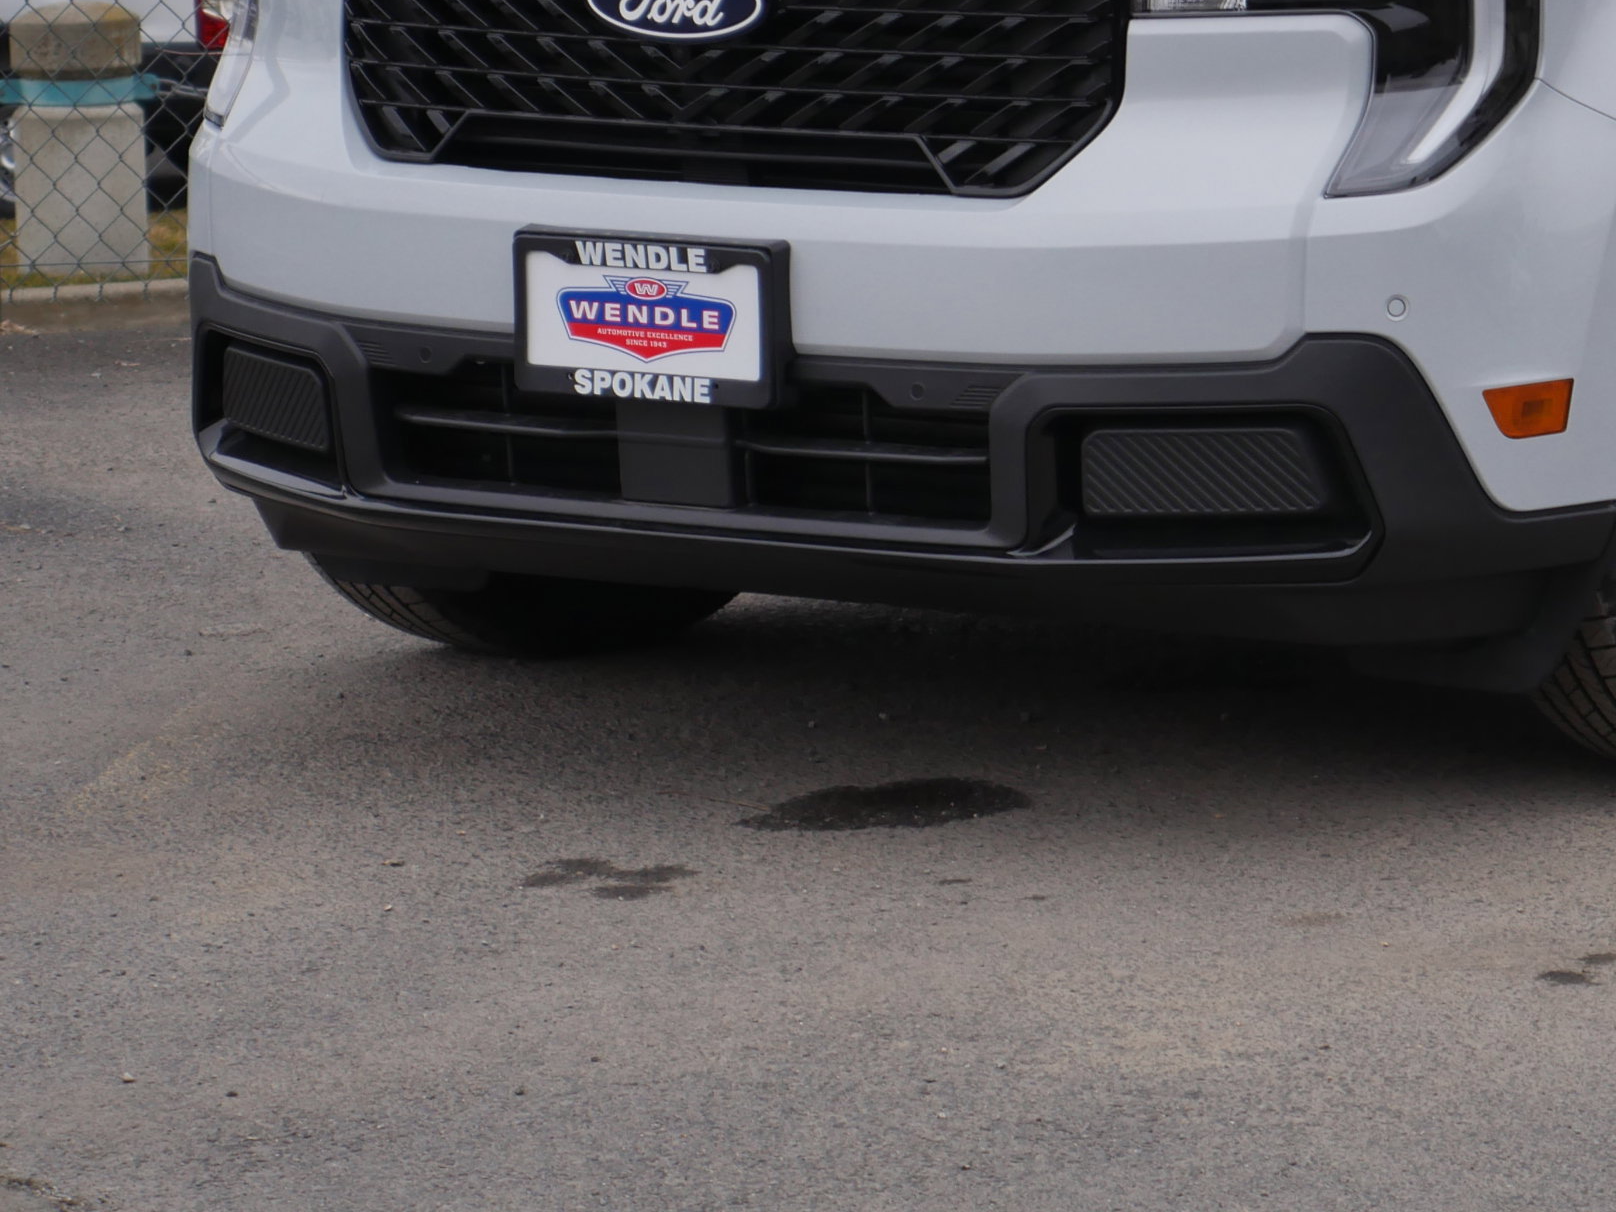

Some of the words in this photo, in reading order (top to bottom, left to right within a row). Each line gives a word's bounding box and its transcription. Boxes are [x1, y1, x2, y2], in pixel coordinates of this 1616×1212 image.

[575, 241, 707, 273] WENDLE
[569, 300, 720, 329] WENDLE
[597, 327, 645, 338] AUTOMOTIVE
[646, 331, 693, 342] EXCELLENCE
[626, 338, 648, 347] SINCE
[650, 340, 667, 348] 1943
[574, 369, 711, 404] SPOKANE
